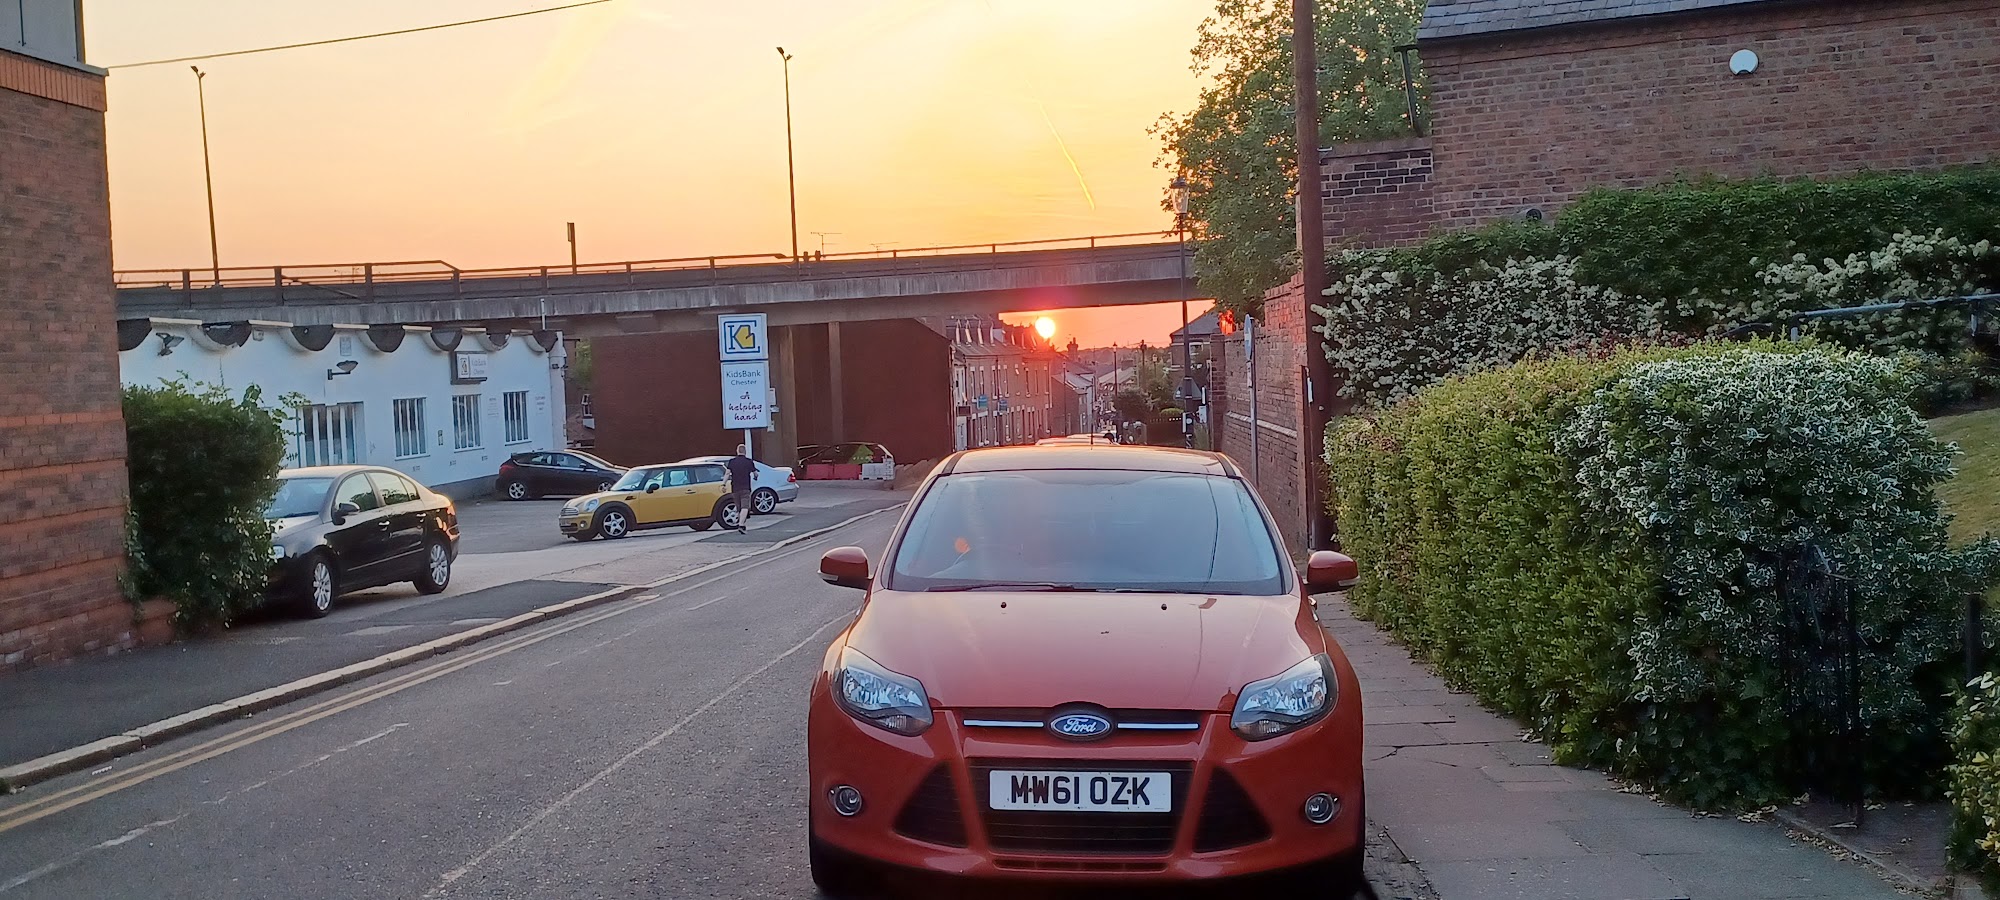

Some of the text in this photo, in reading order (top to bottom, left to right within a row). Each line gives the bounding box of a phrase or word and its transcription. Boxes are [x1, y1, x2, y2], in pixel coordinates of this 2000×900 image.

[726, 370, 761, 378] KidsBank
[728, 403, 762, 413] helping
[734, 413, 758, 421] hand
[1063, 717, 1097, 733] Ford
[1011, 775, 1151, 806] MW61 OZK
